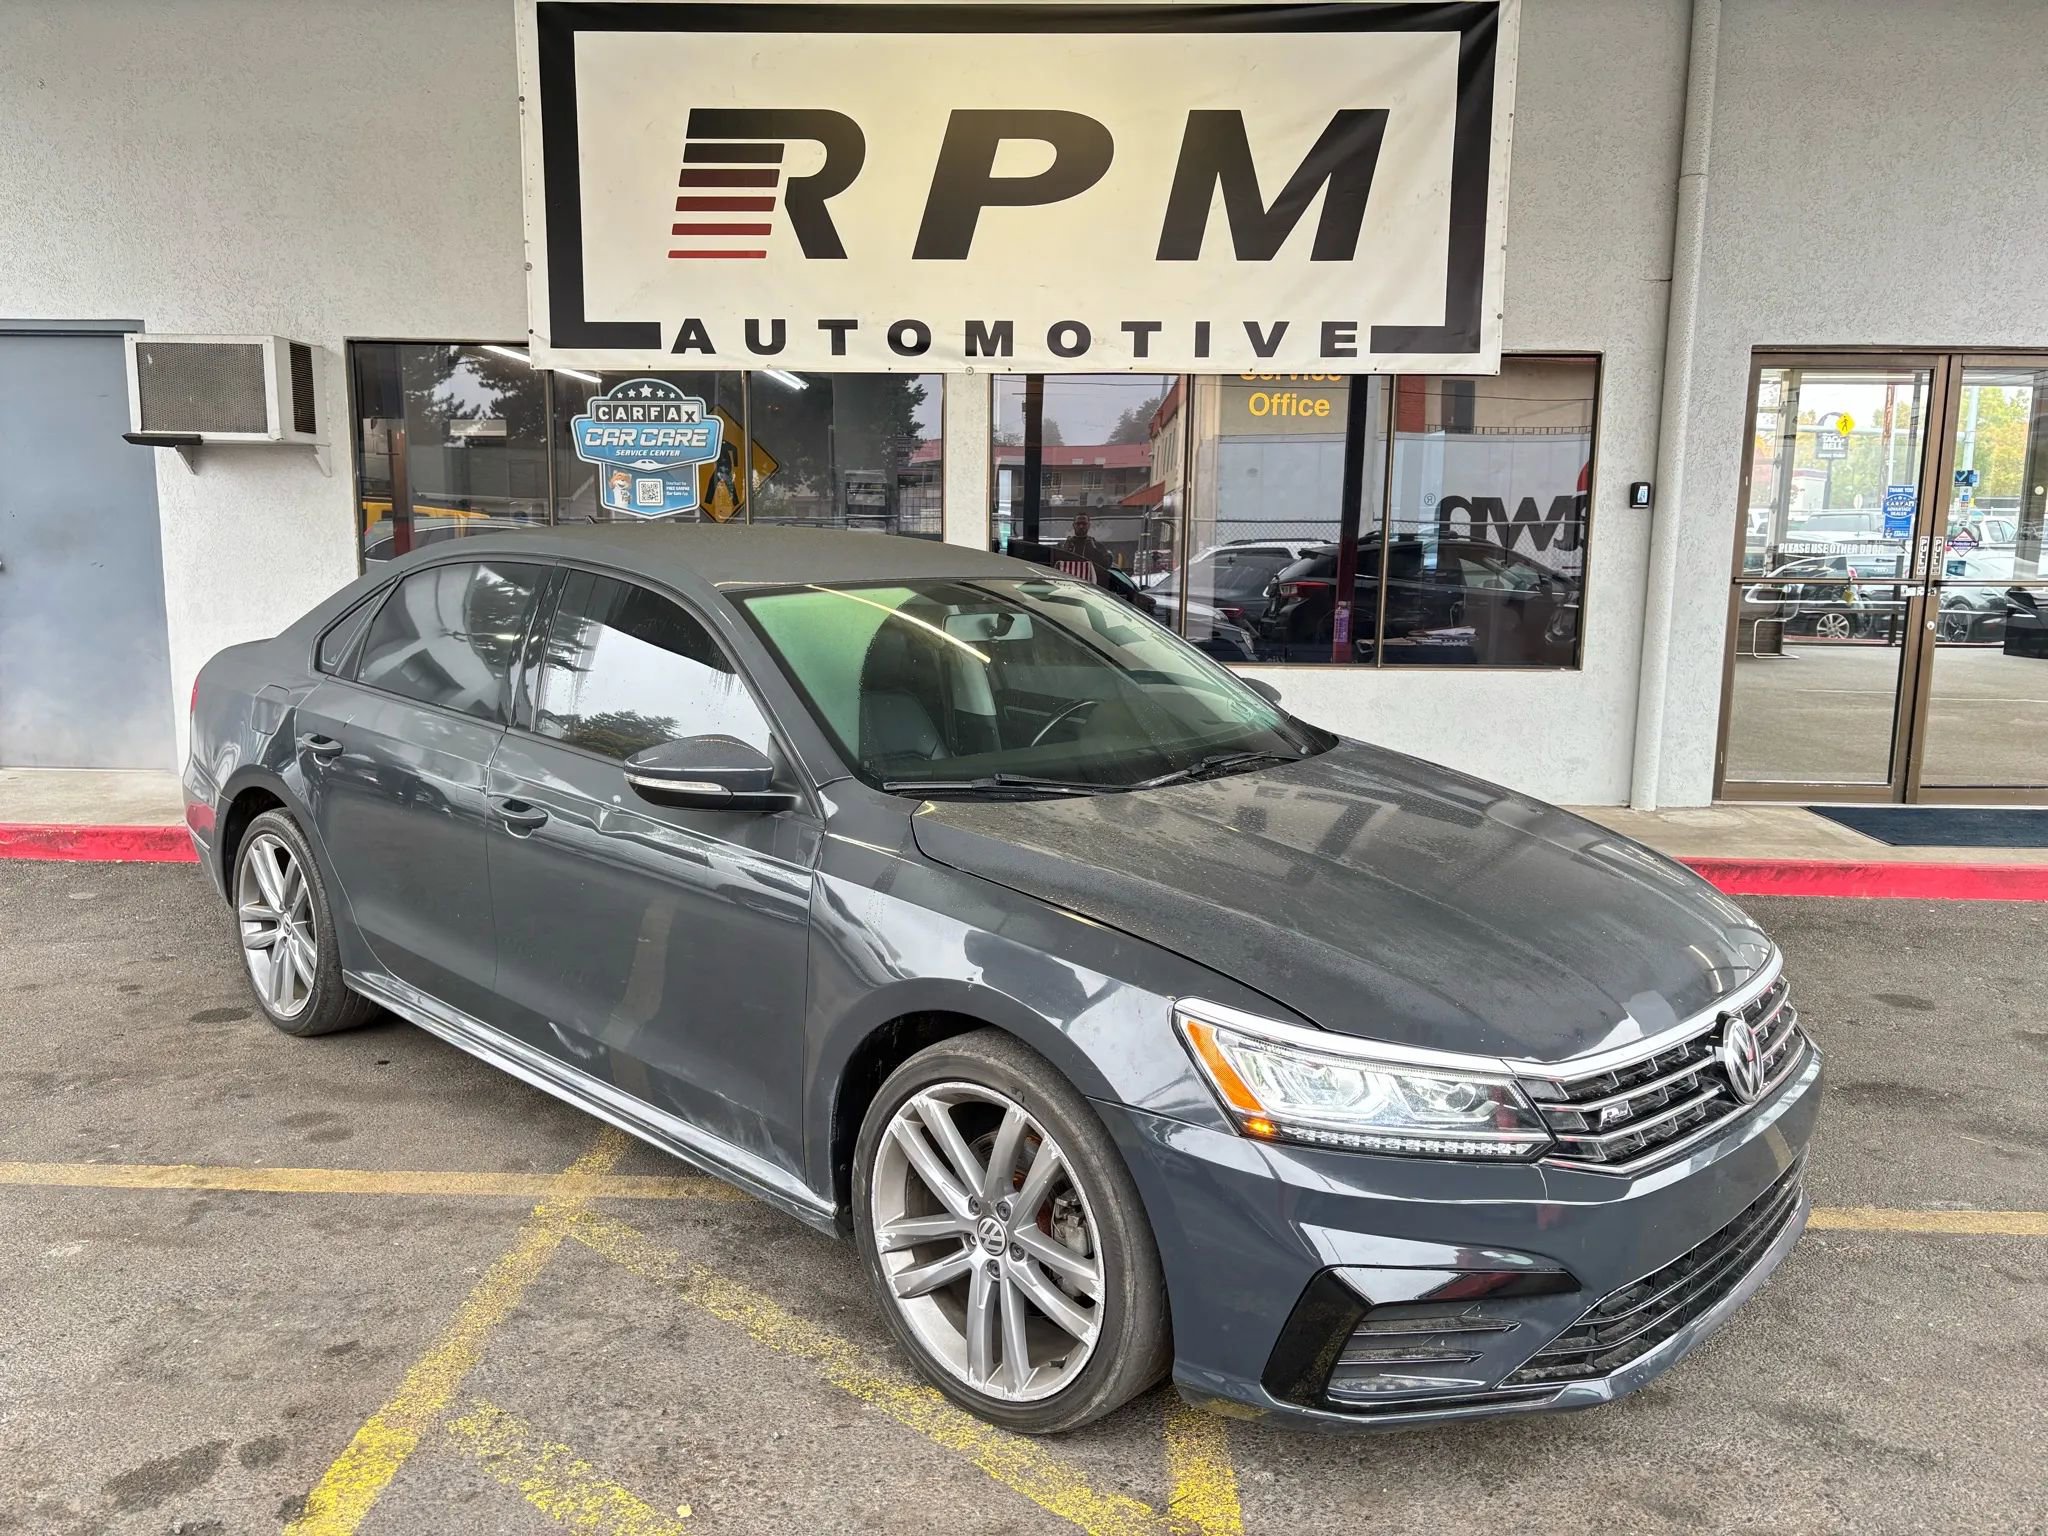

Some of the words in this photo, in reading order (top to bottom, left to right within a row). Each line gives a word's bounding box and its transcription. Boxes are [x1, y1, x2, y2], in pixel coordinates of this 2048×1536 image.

[667, 108, 1390, 260] RPM
[670, 318, 1360, 357] AUTOMOTIVE
[597, 405, 698, 423] CARFAX
[1248, 392, 1331, 417] Office
[584, 428, 638, 447] CAR
[640, 428, 710, 447] CARE
[615, 449, 648, 457] SERVICE
[649, 449, 681, 457] CENTER
[1778, 543, 1810, 554] PLEASE
[1811, 543, 1829, 554] USE
[1829, 543, 1858, 554] OTHER
[1932, 539, 1942, 565] PULL
